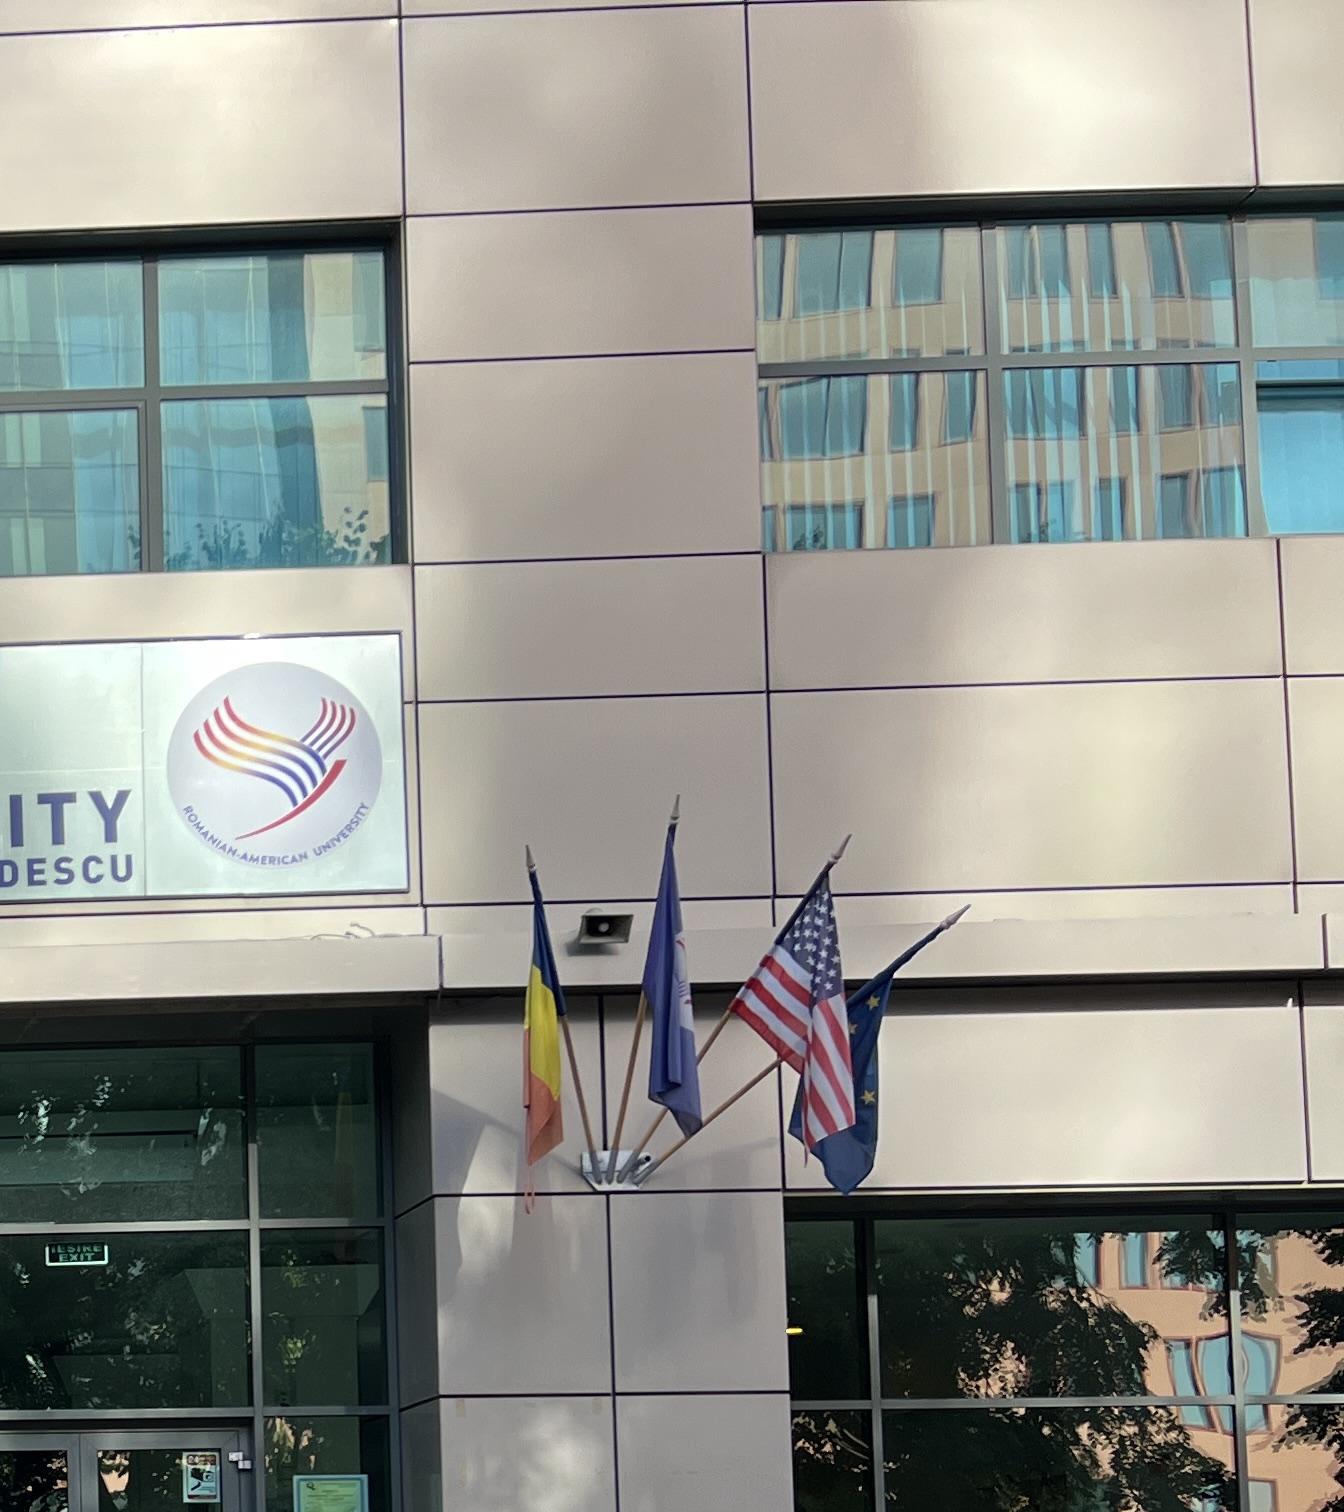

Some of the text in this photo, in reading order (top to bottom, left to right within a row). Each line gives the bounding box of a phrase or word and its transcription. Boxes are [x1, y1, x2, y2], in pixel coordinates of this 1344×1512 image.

[183, 802, 369, 865] ROMANIAN-AMERICAN UNIVERSITY
[59, 1253, 95, 1262] EXIT
